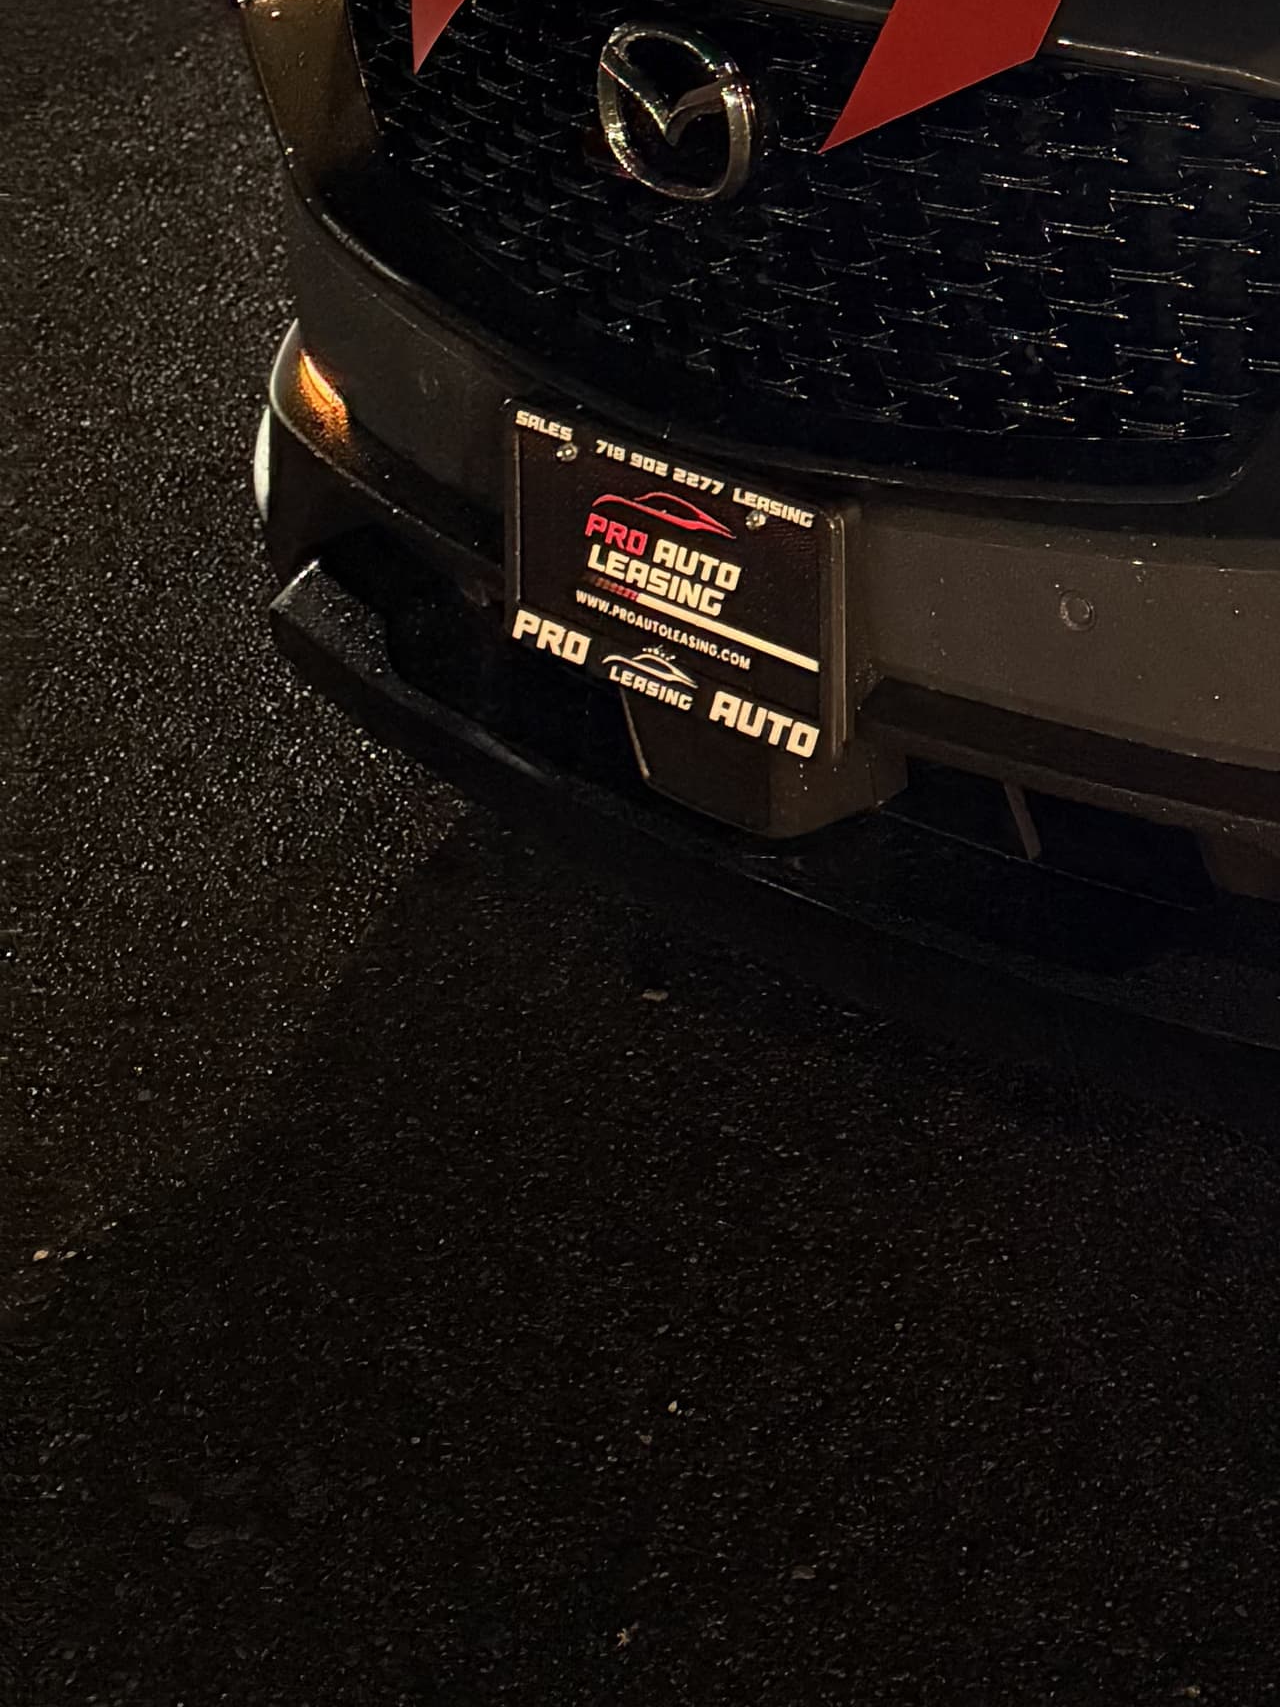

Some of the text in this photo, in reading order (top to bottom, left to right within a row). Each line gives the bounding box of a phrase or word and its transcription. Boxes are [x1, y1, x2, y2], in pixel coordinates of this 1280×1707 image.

[515, 410, 815, 528] SALES 718 902 2277 LEASING
[585, 512, 741, 592] PRO AUTO
[587, 543, 725, 617] LEASING
[575, 589, 751, 671] WWW.PROAUTOLEASING.COM
[512, 609, 820, 759] PRO LEASING AUTO
